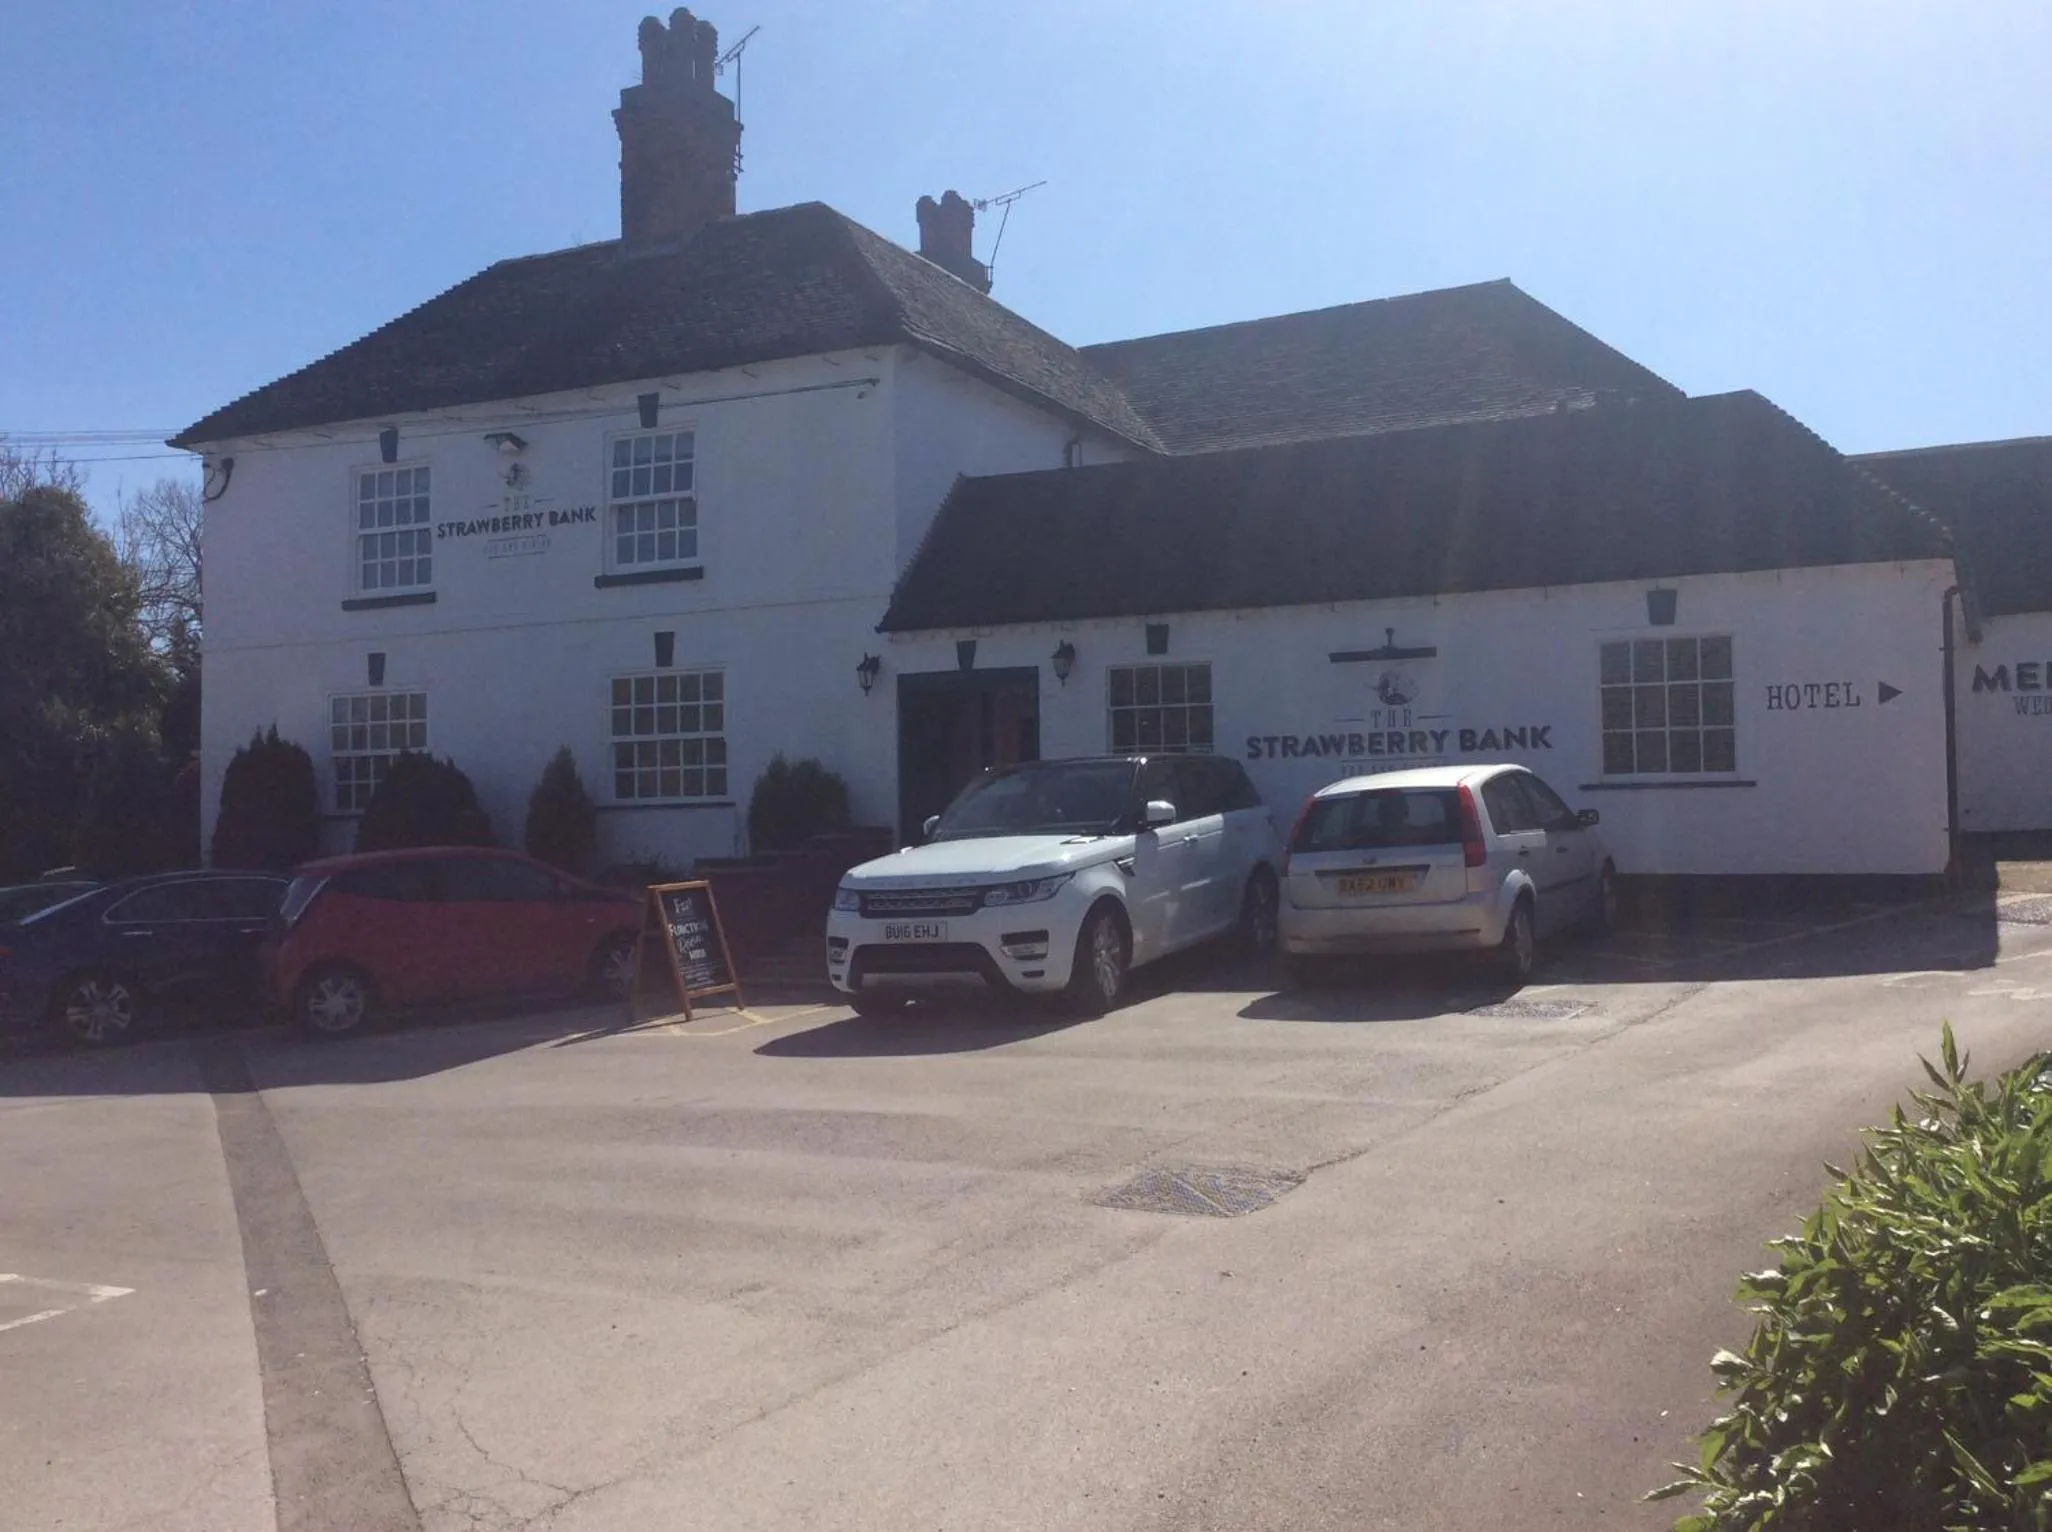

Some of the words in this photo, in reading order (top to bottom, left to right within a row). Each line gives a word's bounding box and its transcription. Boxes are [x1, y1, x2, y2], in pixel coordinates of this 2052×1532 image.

[437, 512, 544, 539] STRAWBERRY
[549, 506, 597, 527] BANK
[1972, 661, 2052, 693] ME
[1766, 682, 1861, 710] HOTEL
[1370, 706, 1413, 729] THE
[1246, 729, 1450, 760] STRAWBERRY
[1459, 725, 1553, 752] BANK
[914, 923, 940, 939] EHJ
